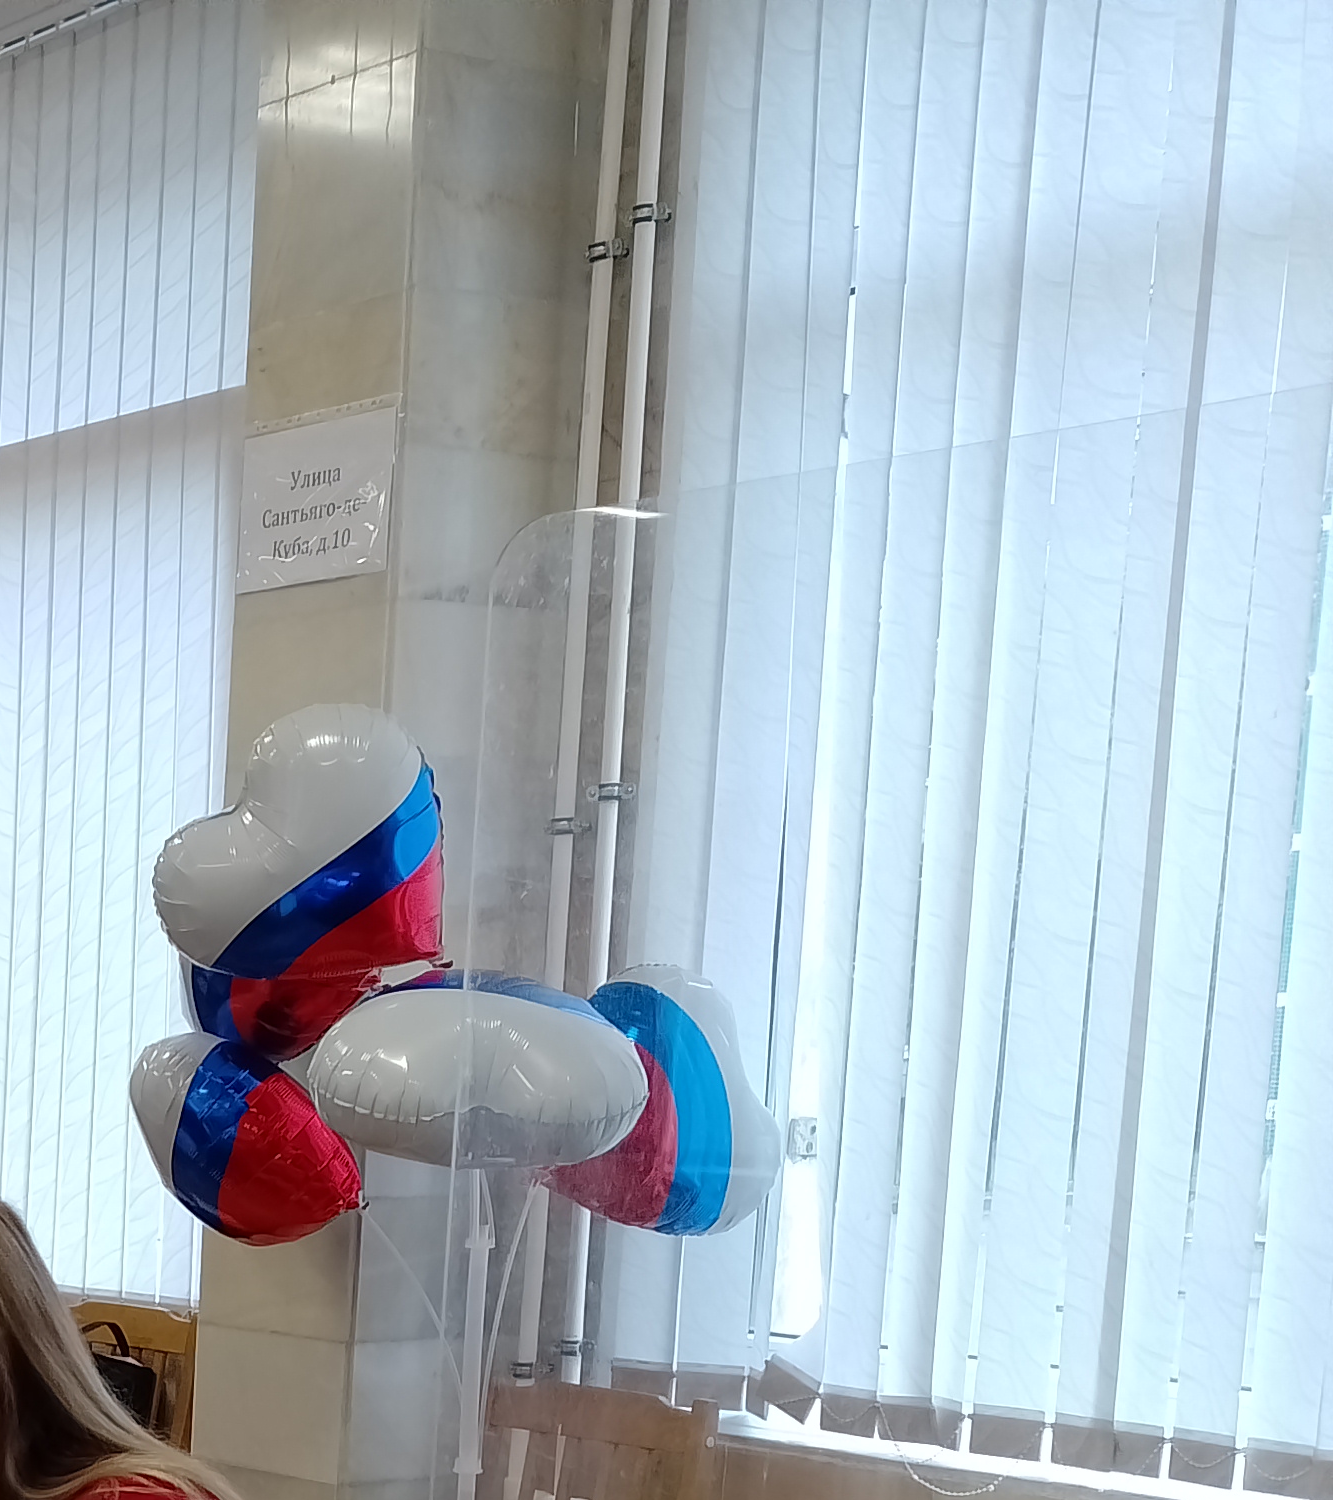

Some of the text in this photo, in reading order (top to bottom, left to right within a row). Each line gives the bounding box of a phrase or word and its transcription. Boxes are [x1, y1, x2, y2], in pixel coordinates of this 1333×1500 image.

[290, 467, 341, 492] Улица
[262, 497, 367, 529] Сантьяго-де-
[272, 535, 314, 562] Куба,
